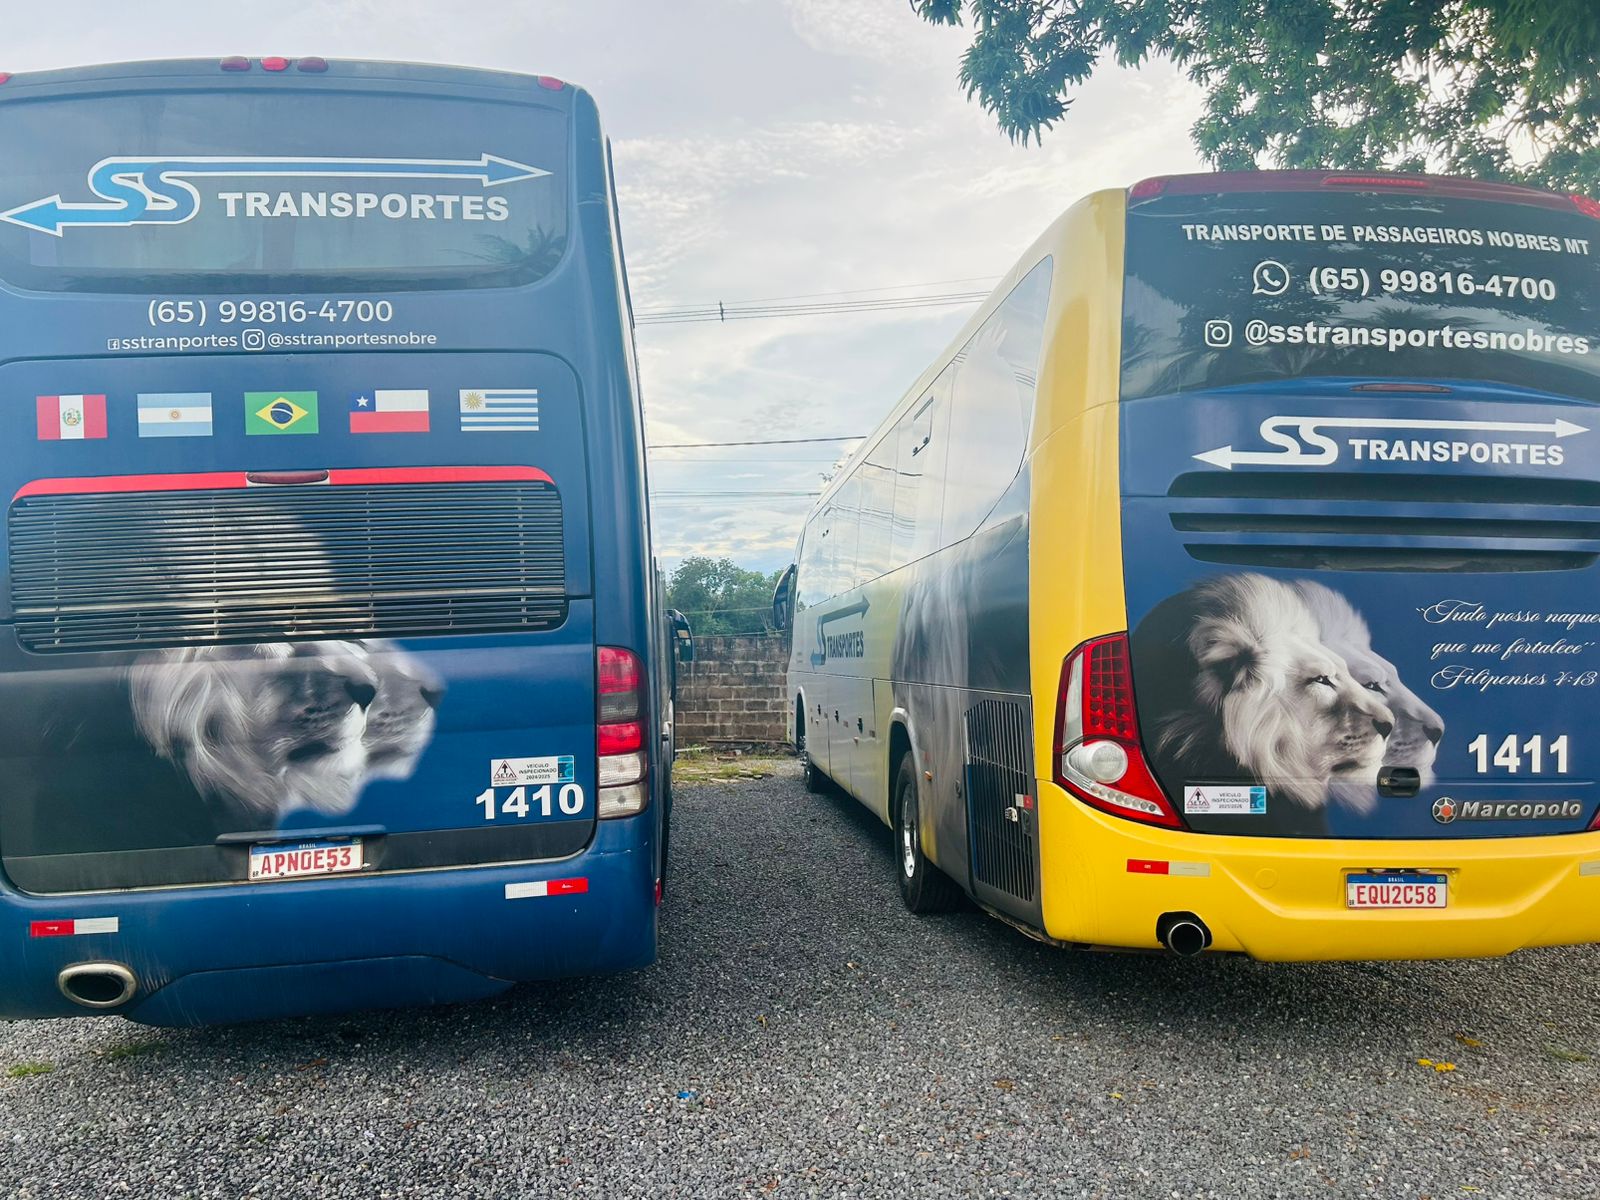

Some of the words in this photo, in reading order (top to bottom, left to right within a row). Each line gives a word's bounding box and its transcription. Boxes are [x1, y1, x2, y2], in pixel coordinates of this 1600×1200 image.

[218, 191, 510, 221] TRANSPORTES
[1182, 224, 1316, 242] TRANSPORTE
[1321, 225, 1346, 241] DE
[1352, 226, 1484, 246] PASSAGEIROS
[1487, 230, 1562, 252] NOBRES
[1564, 237, 1589, 255] MT
[1308, 265, 1370, 296] (65)
[1380, 269, 1557, 300] 99816-4700
[148, 300, 207, 326] (65)
[218, 300, 393, 323] 99816-4700
[121, 334, 238, 350] sstranportes
[267, 331, 437, 347] @sstranportesnobre
[1244, 319, 1590, 354] @sstransportesnobres
[1348, 438, 1564, 466] TRANSPORTES
[1485, 609, 1540, 628] posso
[1545, 613, 1600, 631] naque
[827, 630, 865, 659] TRANSPORTES
[1430, 641, 1466, 660] que
[1471, 642, 1501, 653] me
[1430, 664, 1547, 692] Filipenses
[1468, 733, 1568, 773] 1411
[476, 783, 584, 819] 1410
[1461, 801, 1582, 819] Marcopolo
[1356, 885, 1437, 905] EQU2C58
